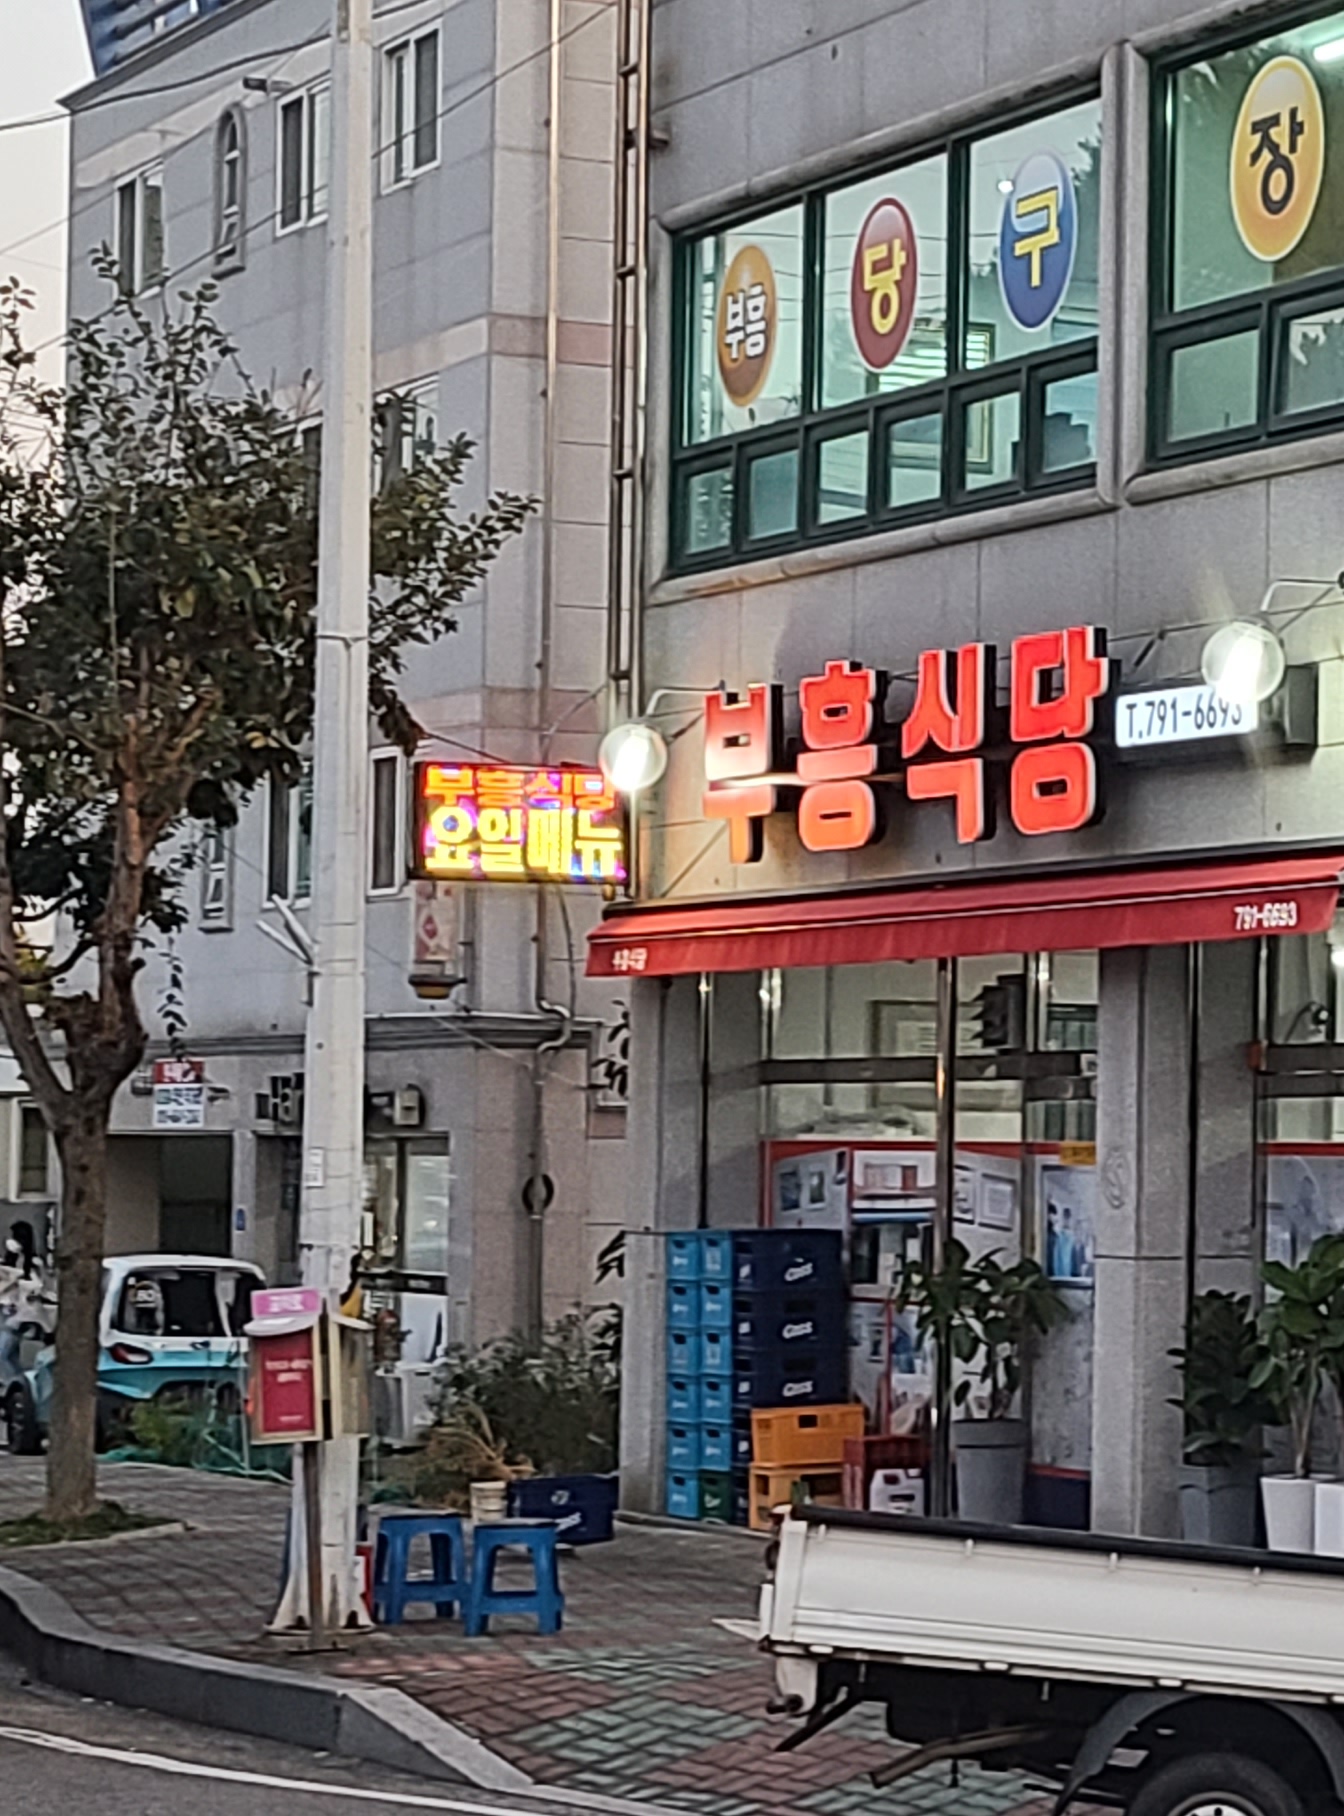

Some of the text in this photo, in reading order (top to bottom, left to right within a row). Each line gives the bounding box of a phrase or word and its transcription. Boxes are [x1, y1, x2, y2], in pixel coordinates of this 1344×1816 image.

[724, 105, 1305, 360] 부흥 당 구 장
[703, 625, 1110, 864] 부흥식당
[424, 764, 615, 808] 부흥식당
[425, 805, 622, 876] 요일메뉴
[1233, 900, 1298, 931] 791-6693
